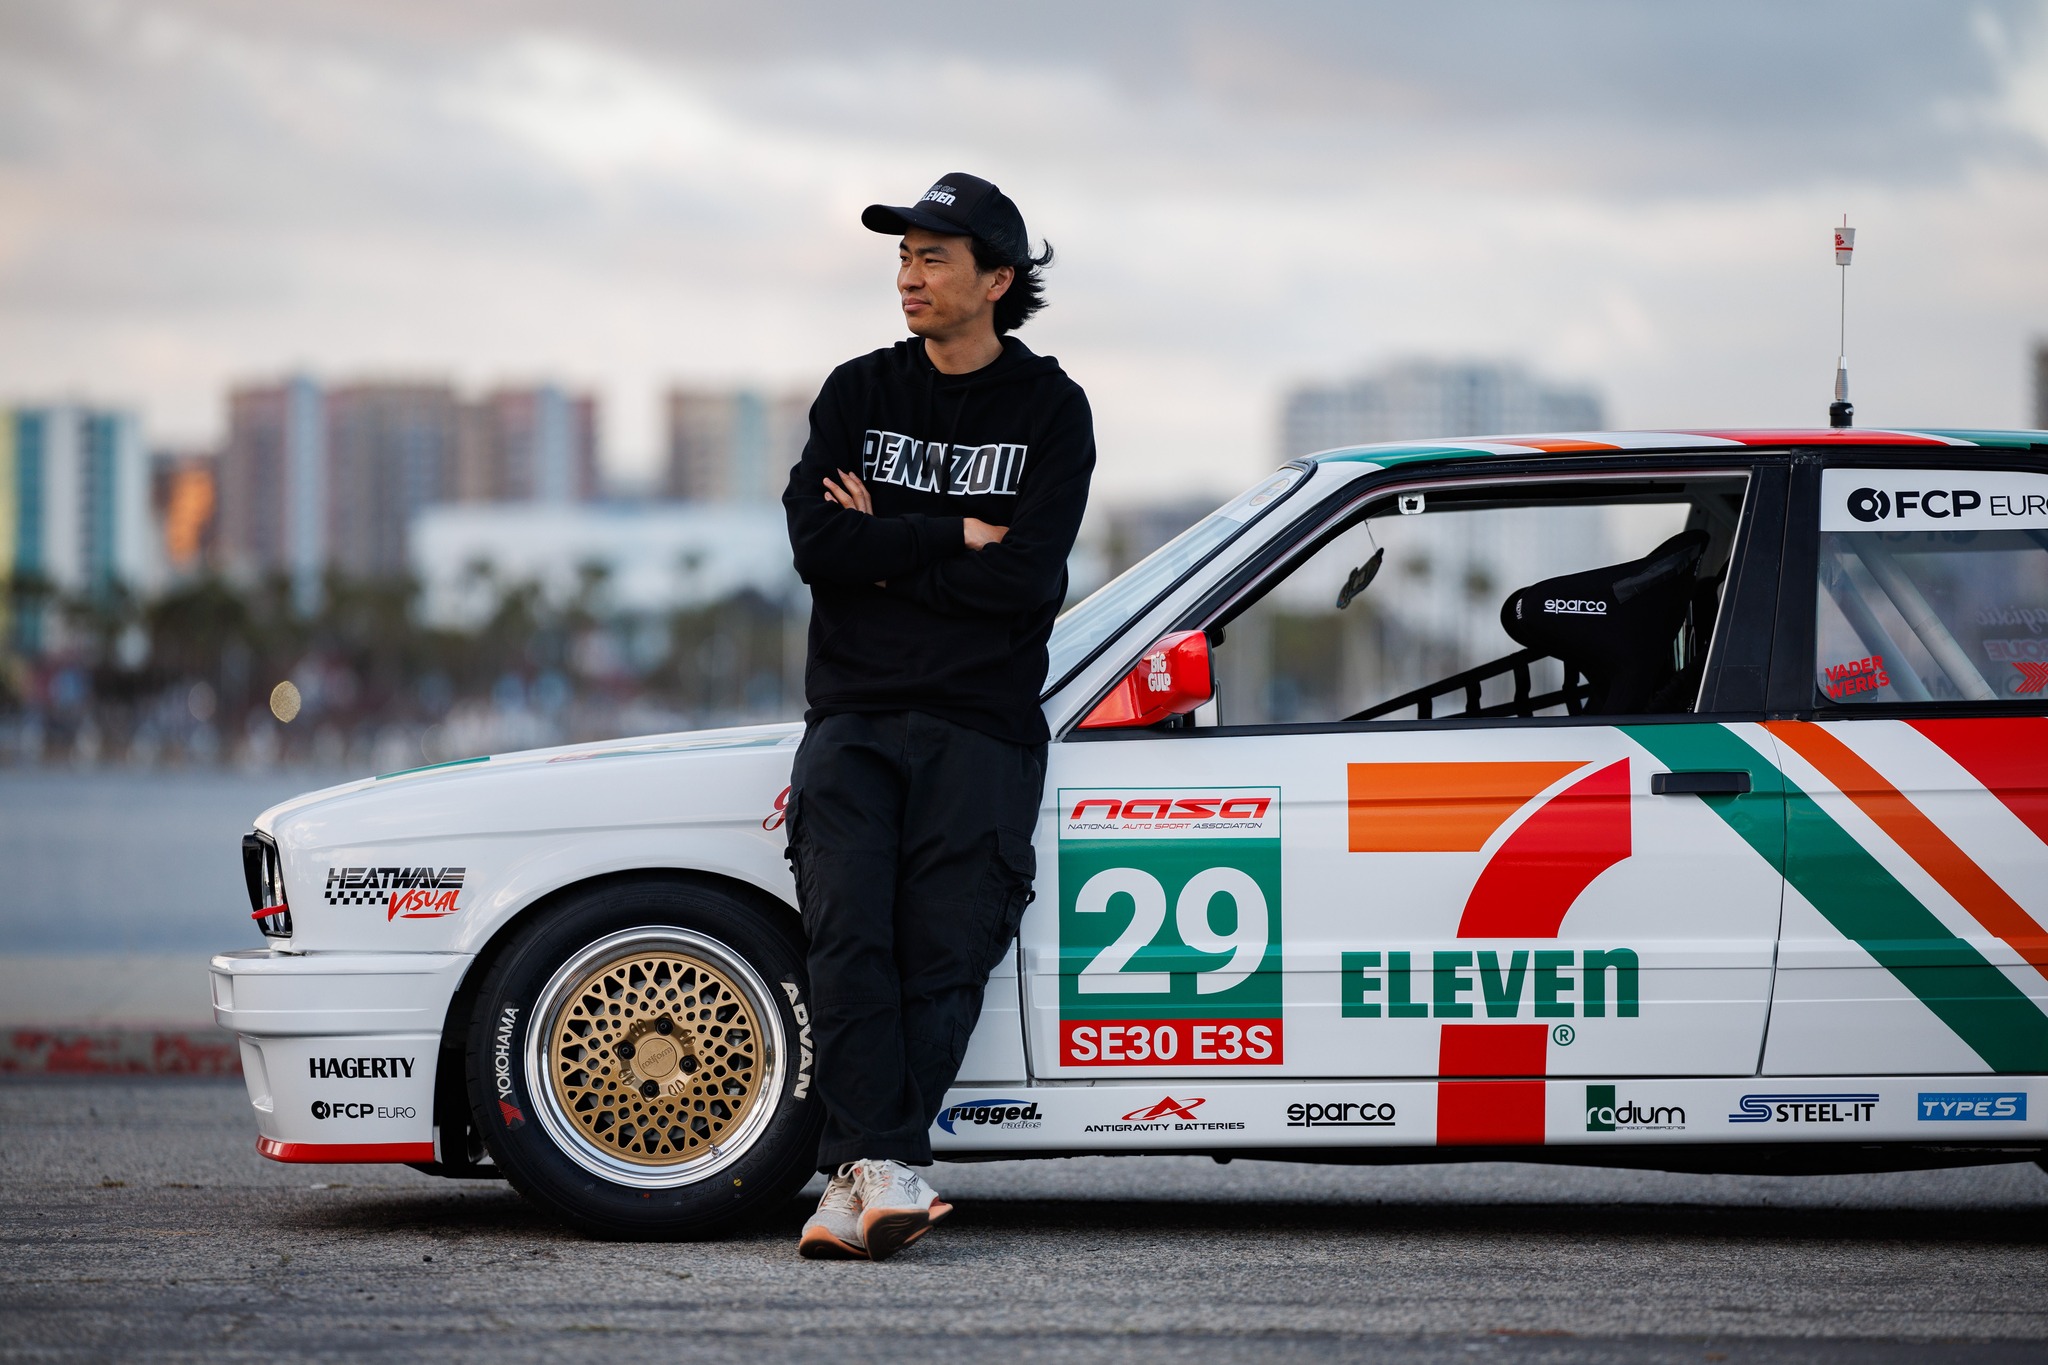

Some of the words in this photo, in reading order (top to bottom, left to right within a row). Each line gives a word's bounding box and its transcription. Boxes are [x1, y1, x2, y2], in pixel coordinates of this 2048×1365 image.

[862, 429, 1028, 496] PENNZOIL
[1895, 489, 1981, 518] FCP
[1990, 494, 2048, 516] EUR
[1544, 598, 1607, 615] sparco
[1824, 655, 1884, 682] VADER
[1148, 672, 1171, 692] GULP
[1826, 671, 1890, 700] WERKS
[1154, 822, 1192, 830] SPORT
[1192, 822, 1262, 830] ASSOCIATION
[326, 867, 467, 889] HEATWAVE
[1074, 866, 1270, 995] 29
[780, 980, 815, 1100] ADVAN
[1070, 1026, 1178, 1061] SE30
[1192, 1024, 1274, 1060] E3S
[495, 1007, 520, 1100] YOKOHAMA
[309, 1057, 416, 1078] HAGERTY
[332, 1102, 374, 1119] FCP
[378, 1106, 416, 1119] EURO
[1286, 1102, 1396, 1128] sparco
[1587, 1100, 1686, 1125] radium
[1776, 1103, 1876, 1122] STEEL-IT
[1000, 1120, 1042, 1130] radios
[1084, 1122, 1170, 1133] ANTIGRAVITY
[1174, 1122, 1246, 1131] BATTERIES
